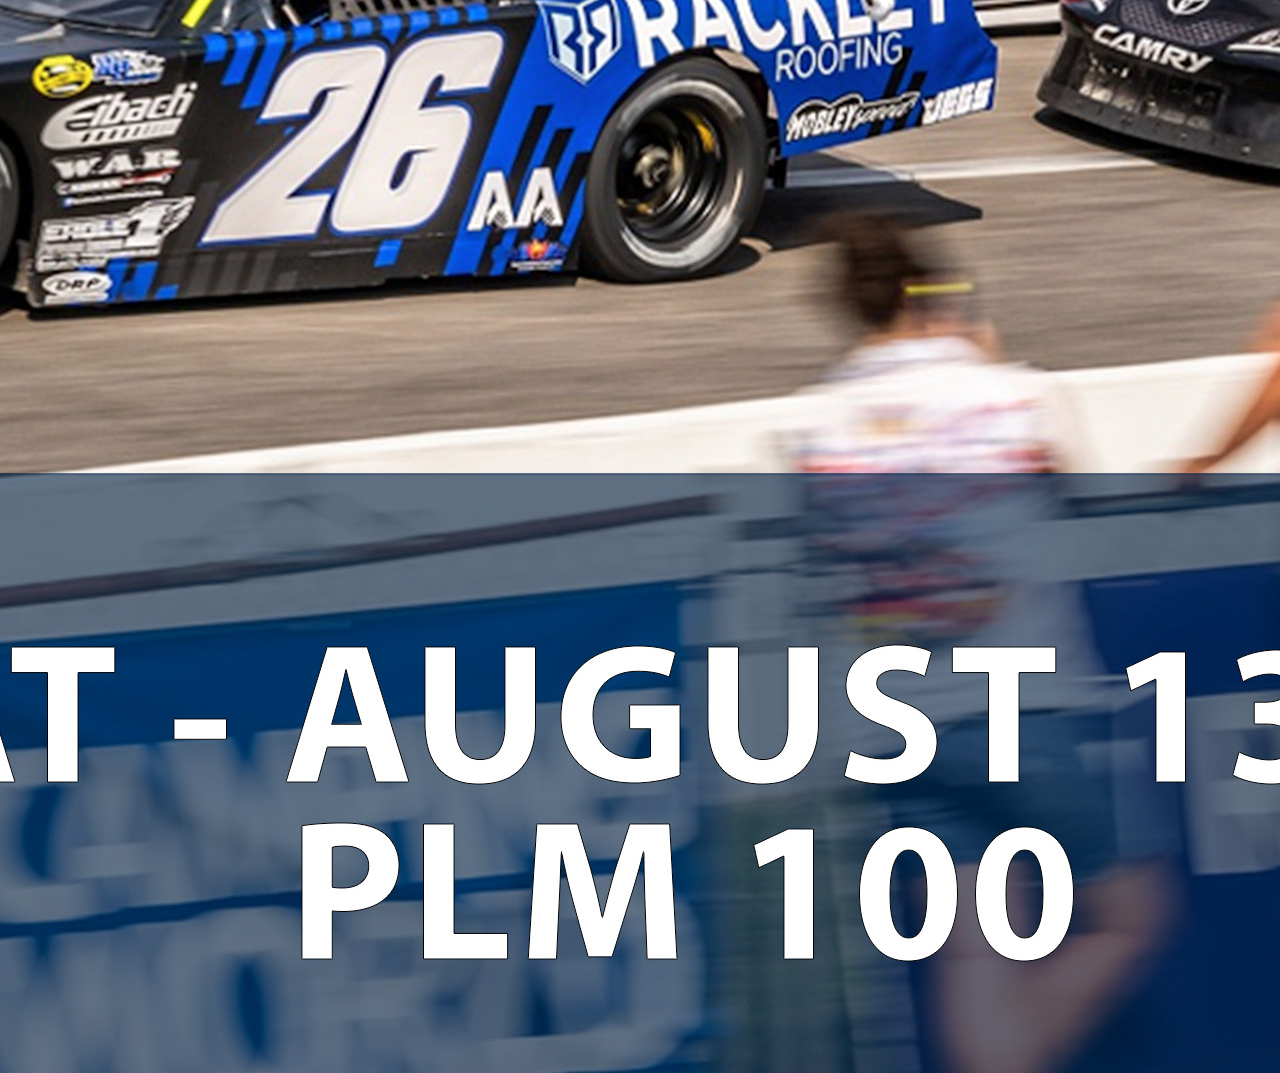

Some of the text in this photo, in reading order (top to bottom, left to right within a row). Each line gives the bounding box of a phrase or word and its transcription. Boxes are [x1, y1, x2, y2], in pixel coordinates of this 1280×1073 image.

[775, 32, 904, 83] ROOFING
[1092, 24, 1214, 74] CAMRY
[200, 27, 505, 247] 26
